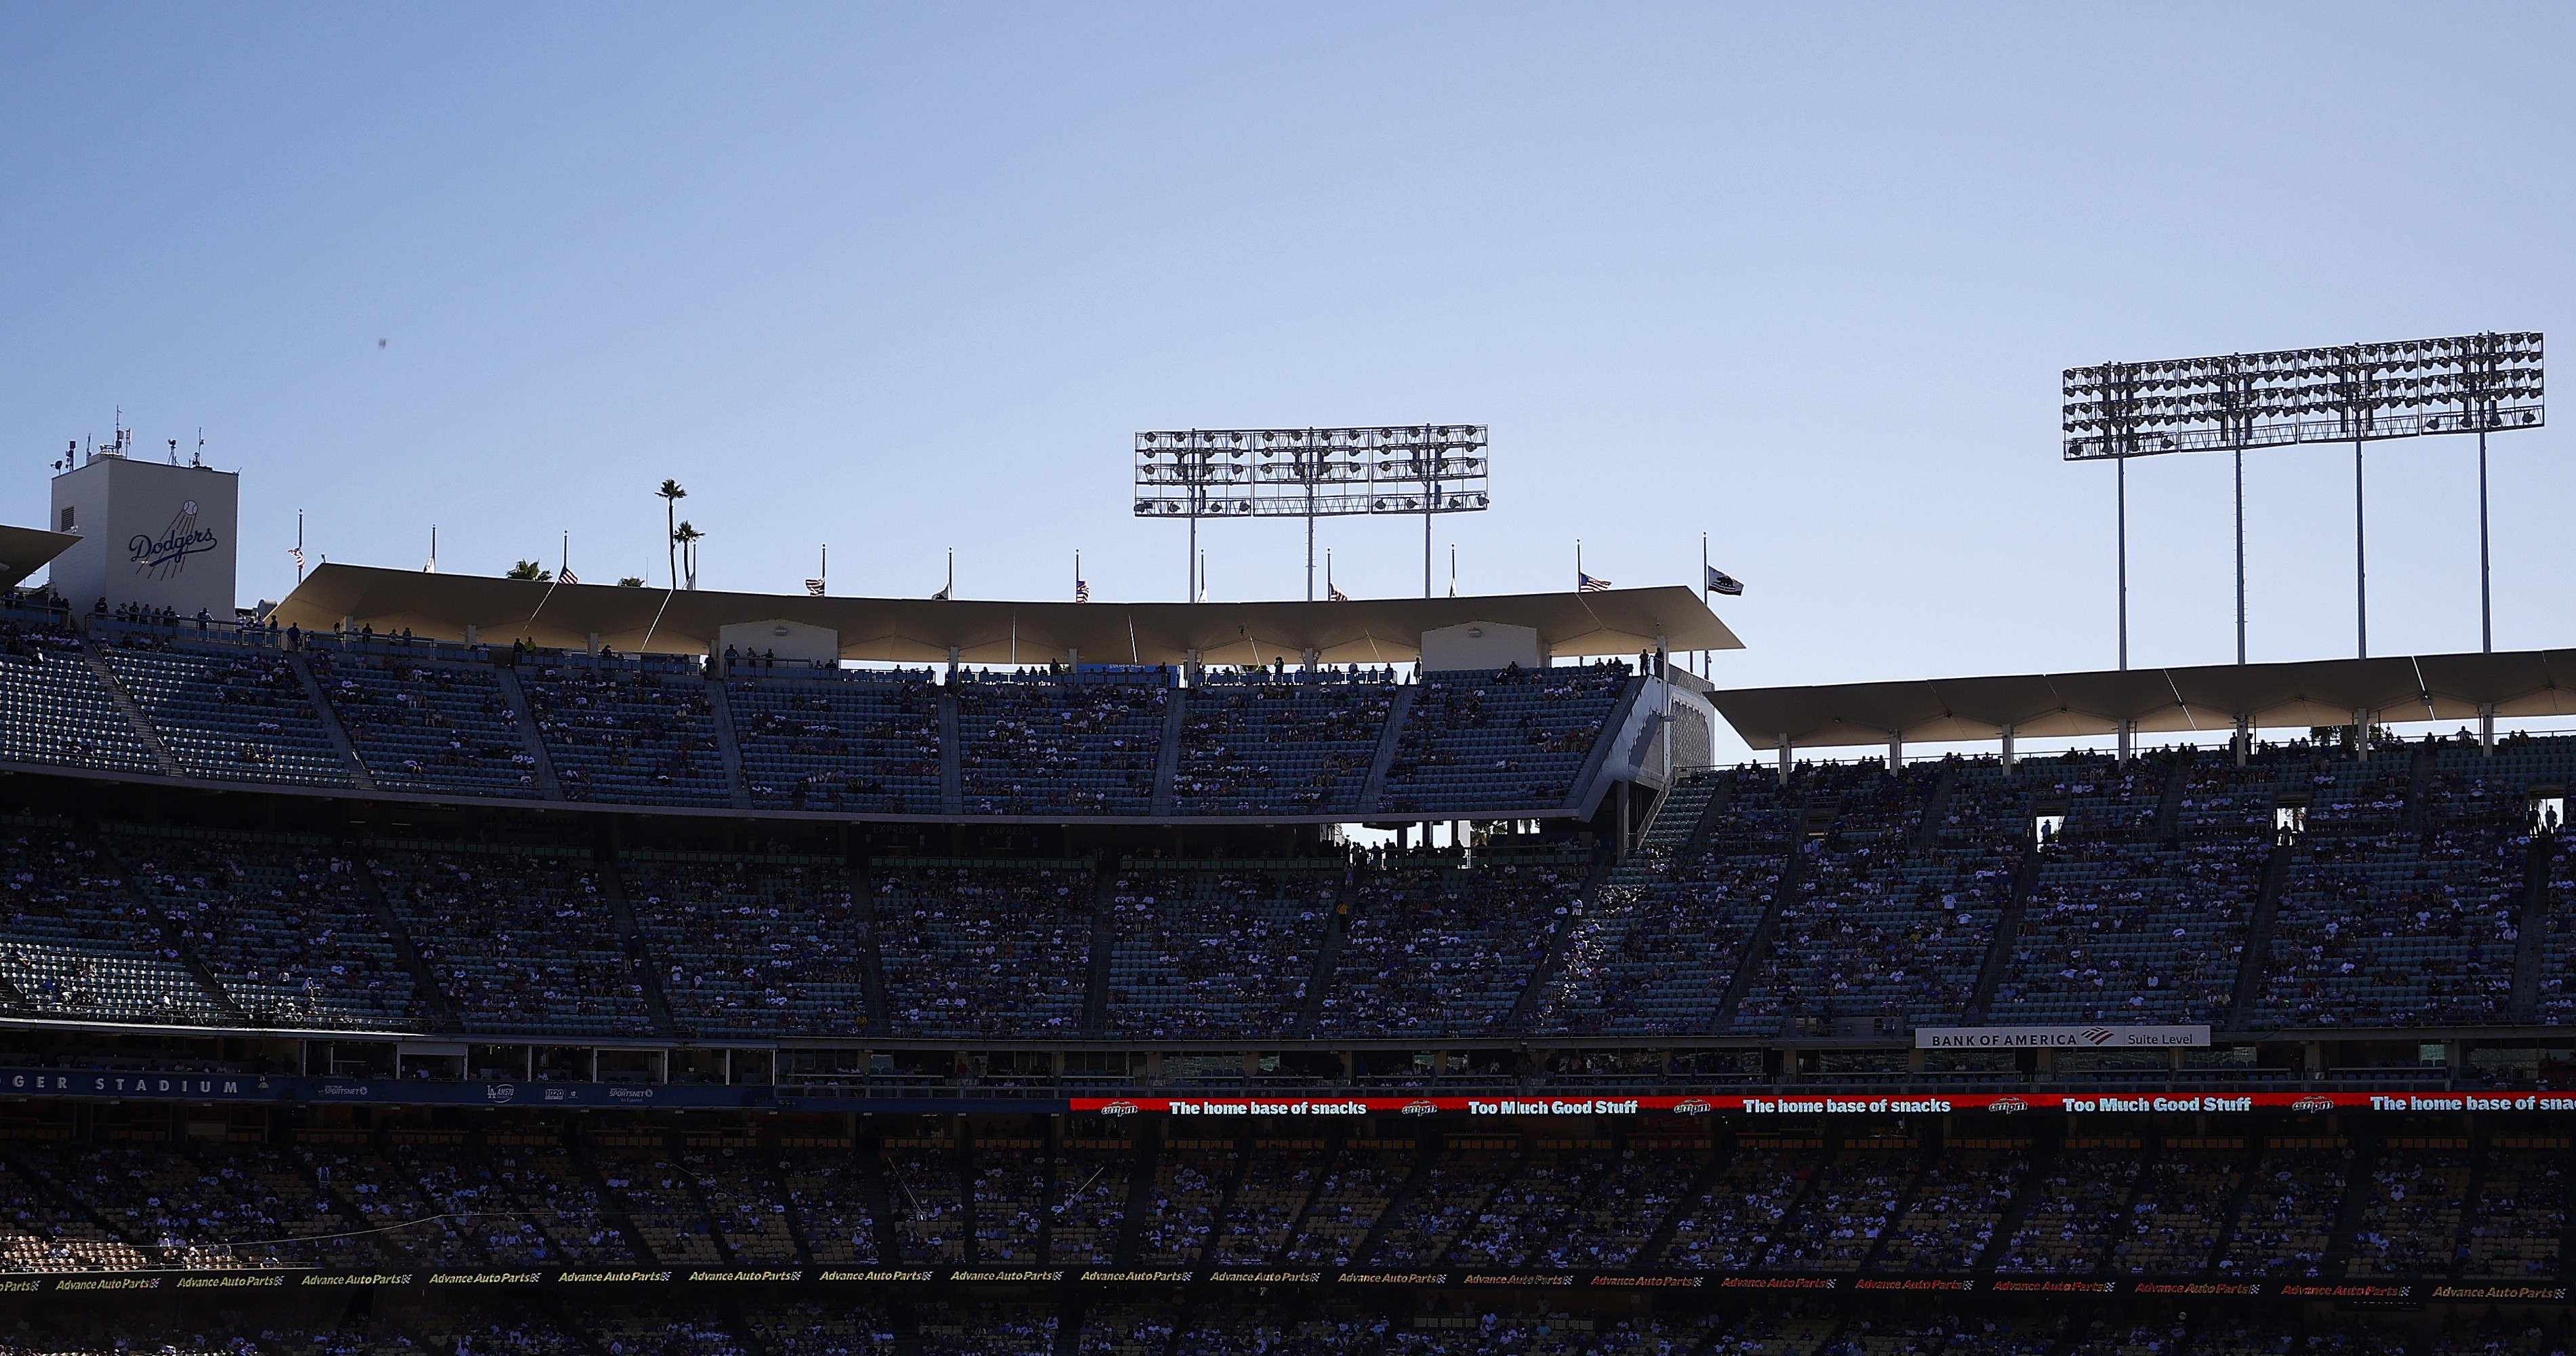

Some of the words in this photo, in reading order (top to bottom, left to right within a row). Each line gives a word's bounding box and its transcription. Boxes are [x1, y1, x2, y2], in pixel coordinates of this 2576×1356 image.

[129, 528, 217, 567] Dodgers
[873, 824, 918, 833] EXPRESS
[986, 826, 1031, 835] EXPRESS
[1932, 1035, 1975, 1046] BANK
[1981, 1035, 2000, 1045] OF
[2004, 1034, 2076, 1045] AMERICA
[2128, 1034, 2158, 1045] Suite
[2162, 1034, 2193, 1044] Level
[0, 1075, 67, 1089] GER
[95, 1077, 238, 1094] STADIUM
[1169, 1102, 1200, 1114] The
[1204, 1102, 1247, 1114] home
[1251, 1102, 1288, 1115] base
[1291, 1102, 1308, 1114] of
[1312, 1101, 1366, 1114] snacks
[1468, 1102, 1497, 1114] Too
[1501, 1101, 1548, 1114] Much
[1552, 1100, 1592, 1114] Good
[1595, 1100, 1638, 1113] Stuff
[1743, 1099, 1775, 1113] The
[1778, 1099, 1824, 1113] home
[1827, 1099, 1866, 1113] base
[1870, 1099, 1887, 1112] of
[1891, 1098, 1950, 1112] snacks
[2063, 1098, 2095, 1111] Too
[2099, 1098, 2149, 1111] Much
[2154, 1097, 2199, 1111] Good
[2204, 1097, 2251, 1111] Stuff
[2371, 1096, 2406, 1110] The
[2411, 1096, 2462, 1110] home
[2467, 1096, 2511, 1110] base
[2515, 1096, 2535, 1109] of
[2540, 1099, 2576, 1109] sna
[302, 1275, 344, 1285] Advance
[346, 1275, 371, 1284] Auto
[373, 1274, 401, 1284] Parts
[429, 1273, 473, 1283] Advance
[475, 1273, 500, 1283] Auto
[501, 1273, 529, 1283] Parts
[558, 1272, 601, 1282] Advance
[603, 1271, 630, 1281] Auto
[632, 1271, 661, 1281] Parts
[689, 1271, 733, 1281] Advance
[734, 1271, 762, 1281] Auto
[763, 1271, 791, 1281] Parts
[820, 1271, 864, 1281] Advance
[865, 1271, 892, 1281] Auto
[893, 1271, 921, 1281] Parts
[950, 1271, 994, 1281] Advance
[996, 1271, 1023, 1281] Auto
[1024, 1271, 1052, 1281] Parts
[1081, 1271, 1124, 1281] Advance
[1125, 1271, 1152, 1281] Auto
[1152, 1271, 1181, 1281] Parts
[1210, 1271, 1253, 1281] Advance
[1254, 1272, 1281, 1281] Auto
[1282, 1272, 1310, 1281] Parts
[1337, 1273, 1380, 1283] Advance
[1382, 1273, 1407, 1283] Auto
[1409, 1273, 1437, 1283] Parts
[1464, 1274, 1508, 1284] Advance
[1509, 1275, 1534, 1285] Auto
[1535, 1275, 1564, 1285] Parts
[1591, 1276, 1633, 1285] Advance
[1635, 1277, 1662, 1286] Auto
[1663, 1277, 1693, 1286] Parts
[5, 1281, 31, 1291] Parts
[56, 1279, 96, 1290] Advance
[98, 1279, 121, 1290] Auto
[122, 1278, 149, 1289] Parts
[177, 1277, 218, 1288] Advance
[221, 1277, 246, 1286] Auto
[247, 1276, 273, 1286] Parts
[1722, 1277, 1765, 1288] Advance
[1767, 1278, 1794, 1288] Auto
[1796, 1278, 1826, 1288] Parts
[1855, 1279, 1901, 1289] Advance
[1902, 1279, 1931, 1289] Auto
[1932, 1279, 1963, 1290] Parts
[1993, 1281, 2040, 1291] Advance
[2042, 1281, 2071, 1291] Auto
[2072, 1281, 2104, 1292] Parts
[2135, 1283, 2183, 1293] Advance
[2185, 1283, 2215, 1294] Auto
[2216, 1284, 2249, 1294] Parts
[2281, 1285, 2332, 1295] Advance
[2334, 1285, 2364, 1296] Auto
[2365, 1286, 2399, 1296] Parts
[2432, 1286, 2483, 1297] Advance
[2486, 1288, 2518, 1298] Auto
[2519, 1288, 2554, 1298] Parts
